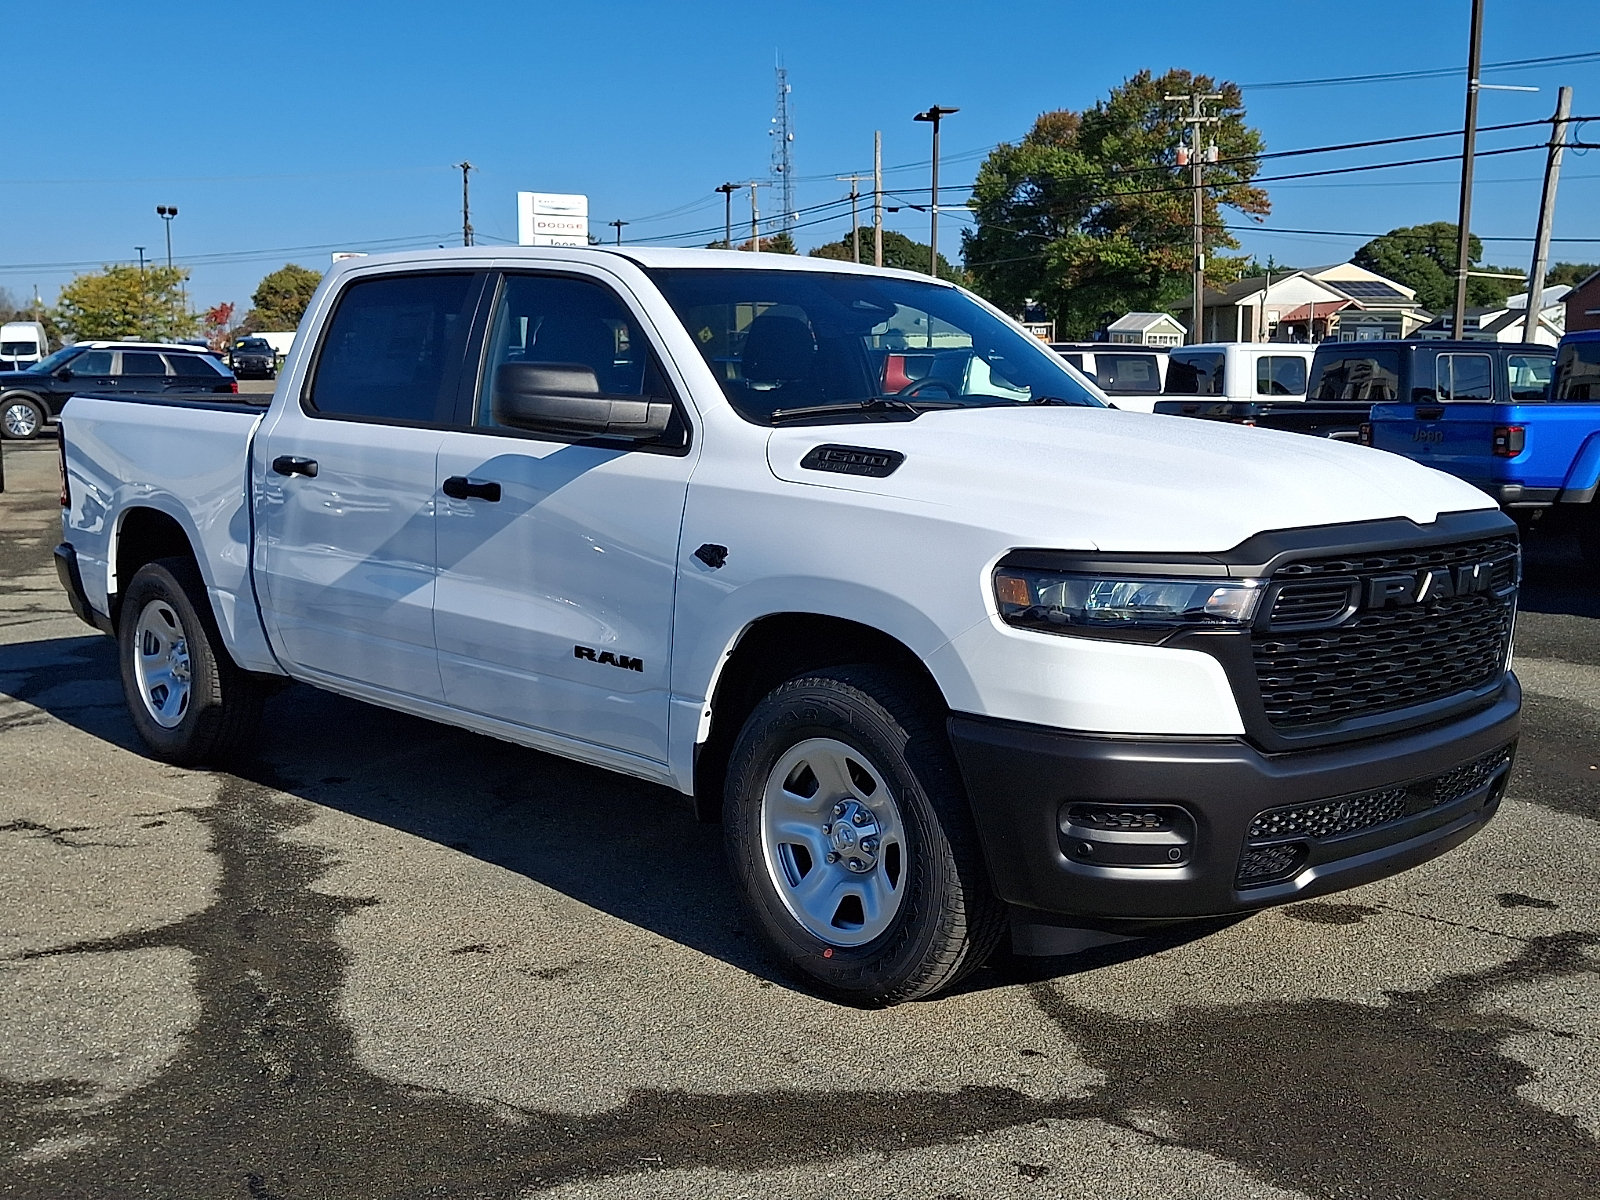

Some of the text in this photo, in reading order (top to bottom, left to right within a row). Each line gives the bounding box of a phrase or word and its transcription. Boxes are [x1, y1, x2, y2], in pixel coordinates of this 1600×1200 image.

[1412, 426, 1444, 444] Jeep
[817, 449, 890, 468] 1500
[1367, 562, 1493, 608] RAM
[574, 644, 644, 673] RAM
[731, 705, 818, 848] GOODYEAR
